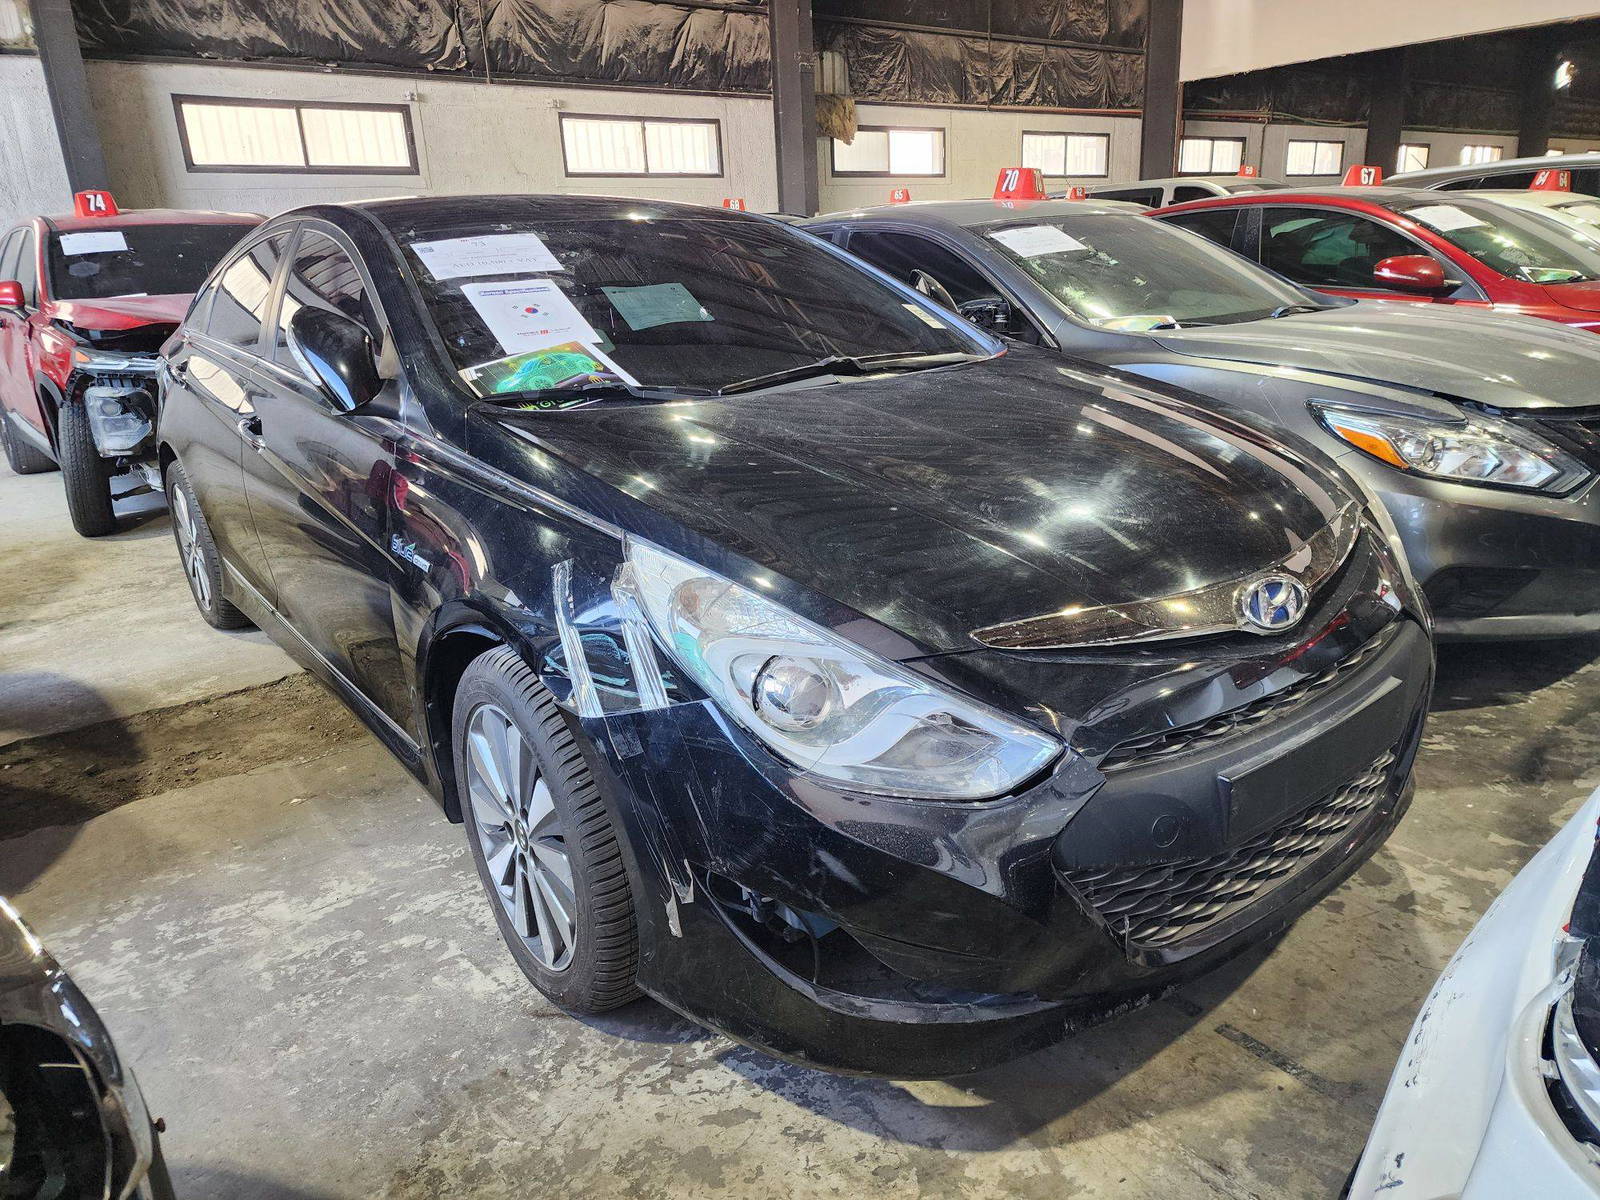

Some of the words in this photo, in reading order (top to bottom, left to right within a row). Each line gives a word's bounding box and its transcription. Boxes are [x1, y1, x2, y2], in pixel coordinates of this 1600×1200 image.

[1001, 169, 1019, 192] 70
[1361, 168, 1375, 185] 67
[86, 194, 106, 211] 74
